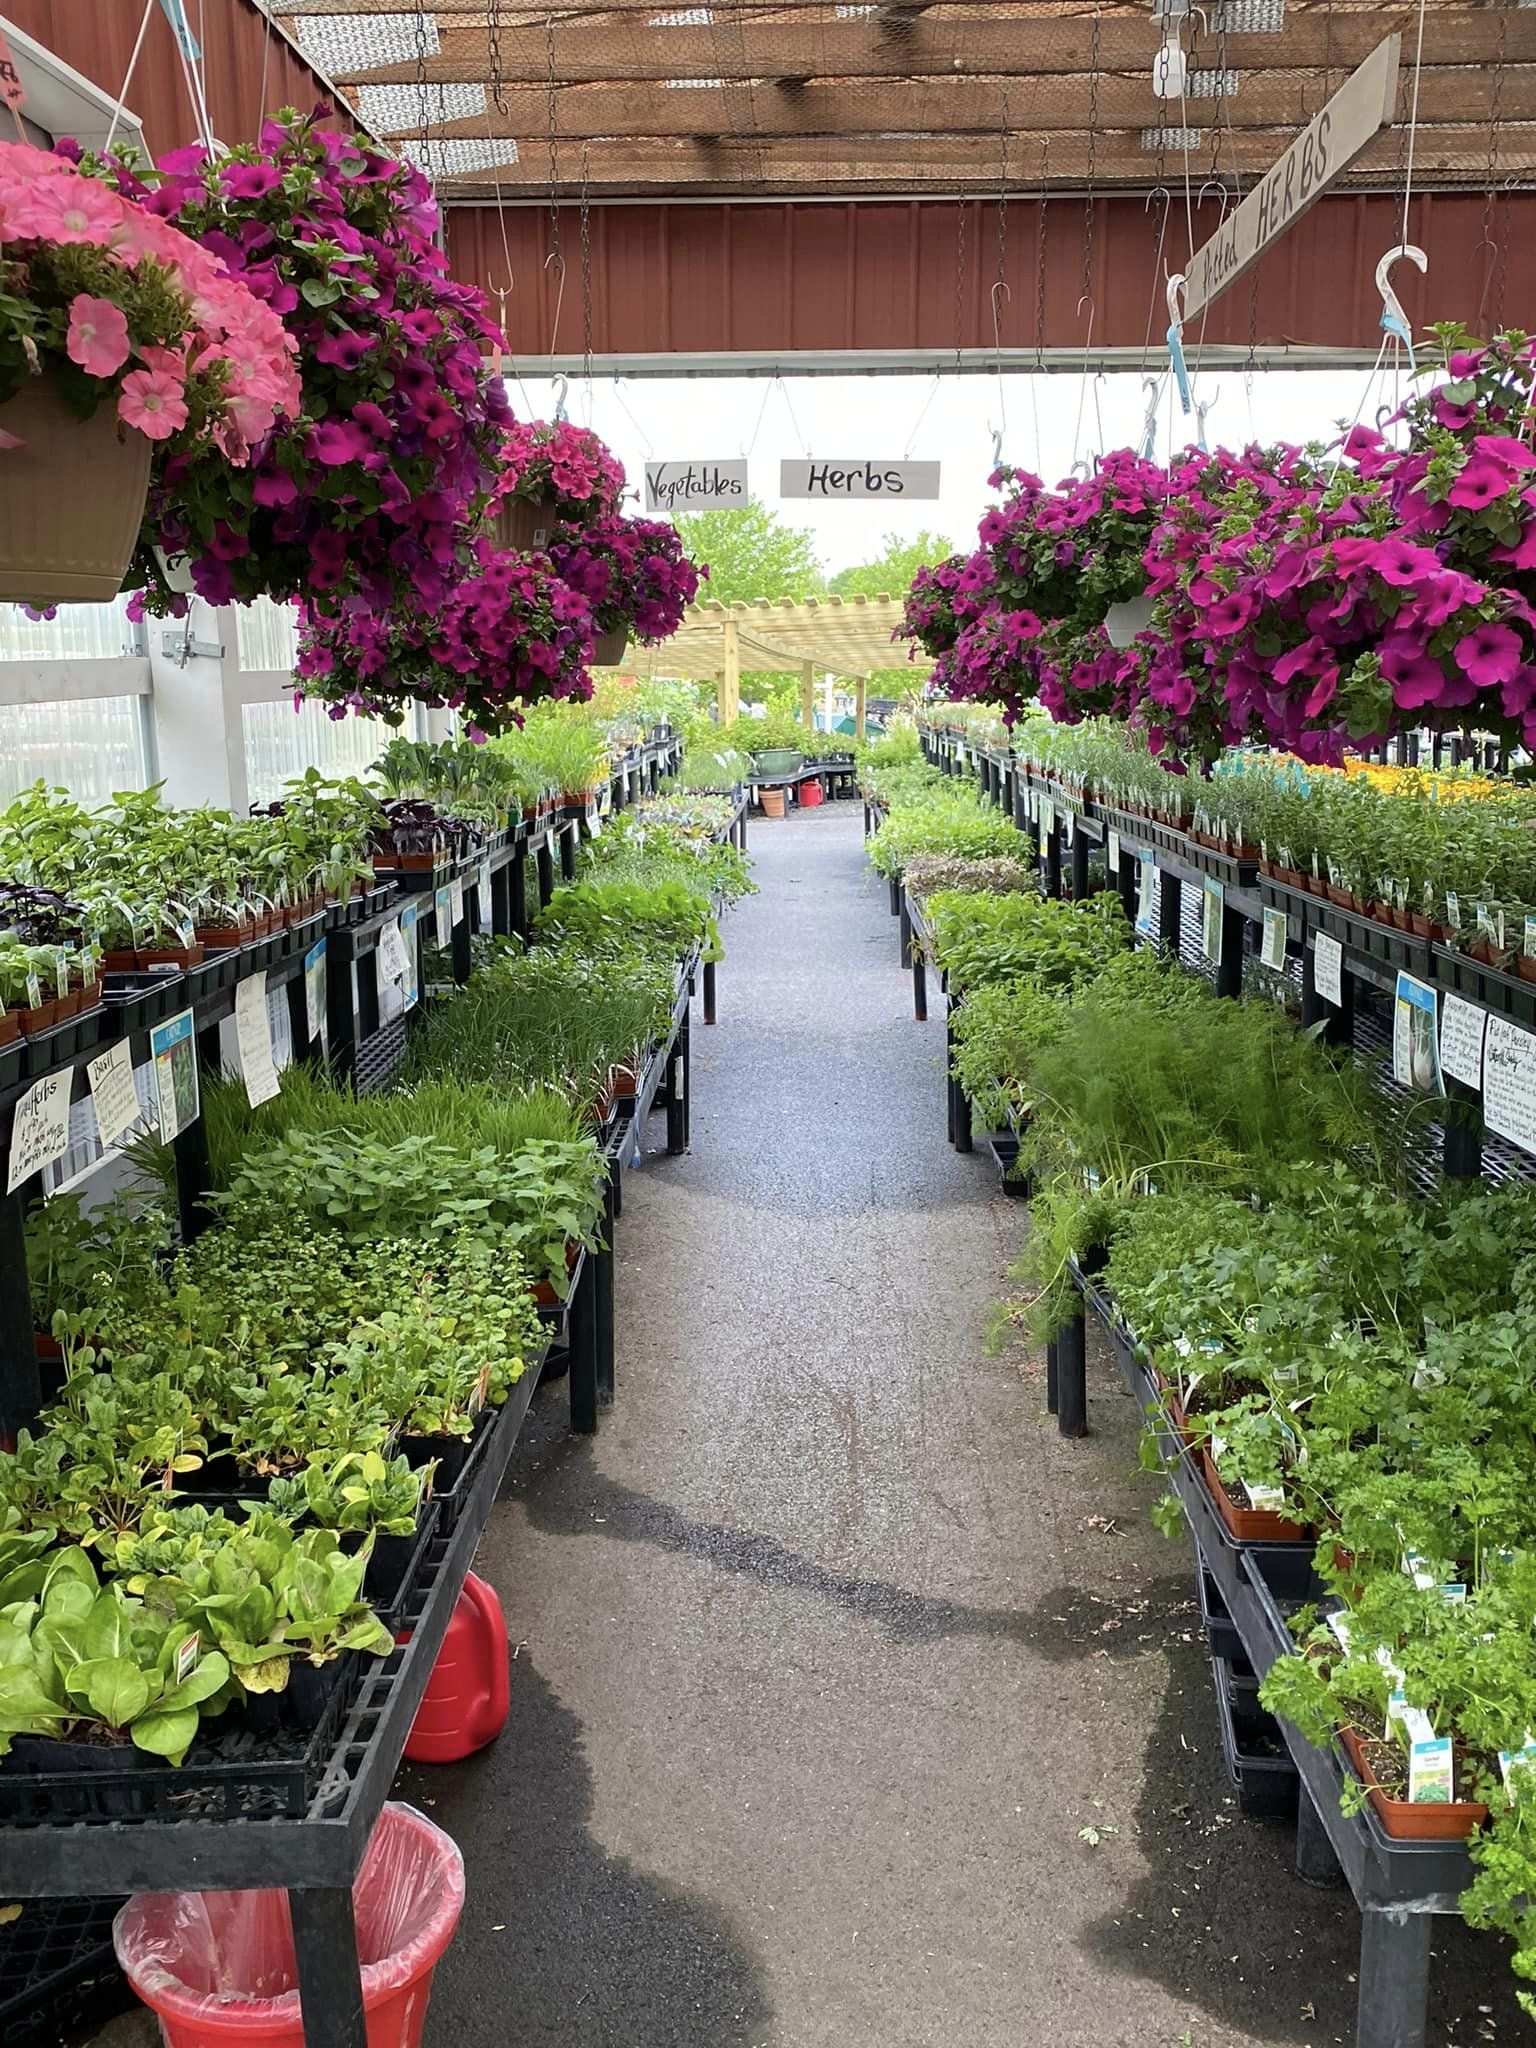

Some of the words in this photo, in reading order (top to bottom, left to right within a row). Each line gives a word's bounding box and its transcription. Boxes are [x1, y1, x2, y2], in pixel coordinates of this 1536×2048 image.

[1255, 111, 1331, 250] HERBS
[646, 462, 743, 510] Vegetables
[807, 461, 905, 496] Herbs
[93, 1050, 115, 1081] Basil
